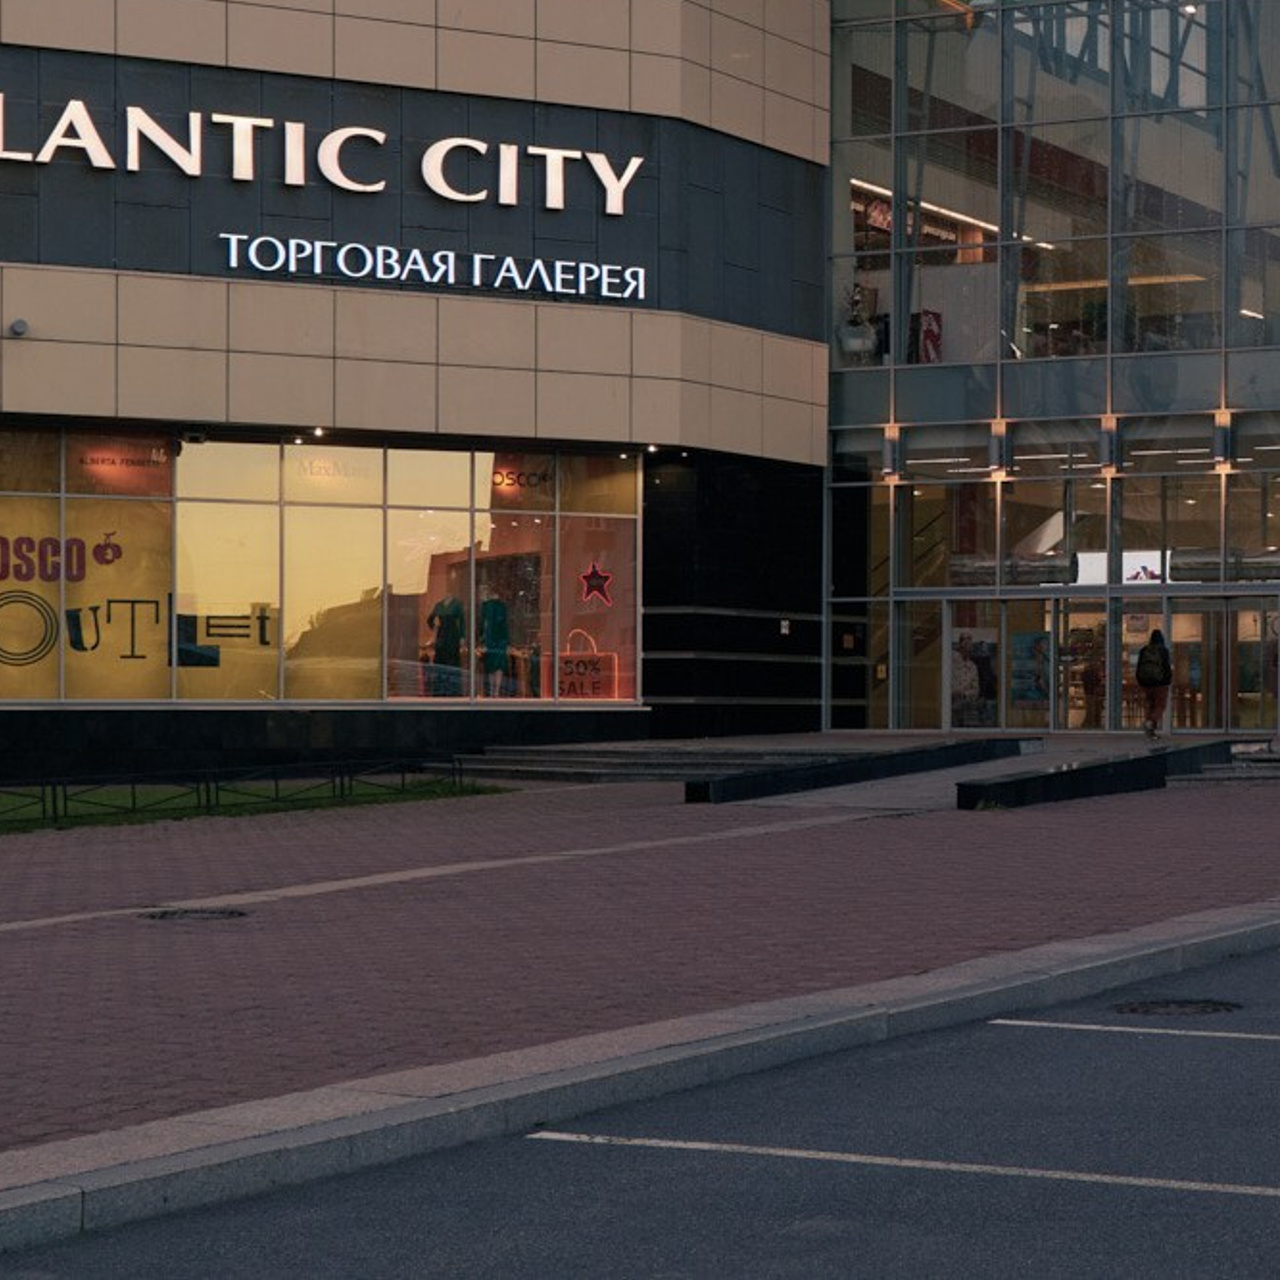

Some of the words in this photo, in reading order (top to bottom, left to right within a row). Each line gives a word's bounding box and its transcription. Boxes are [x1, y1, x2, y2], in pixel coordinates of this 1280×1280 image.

[0, 93, 387, 193] LANTIC
[421, 137, 645, 216] CITY
[219, 232, 456, 285] ТОРГОВАЯ
[472, 253, 646, 300] ГАЛЕРЕЯ
